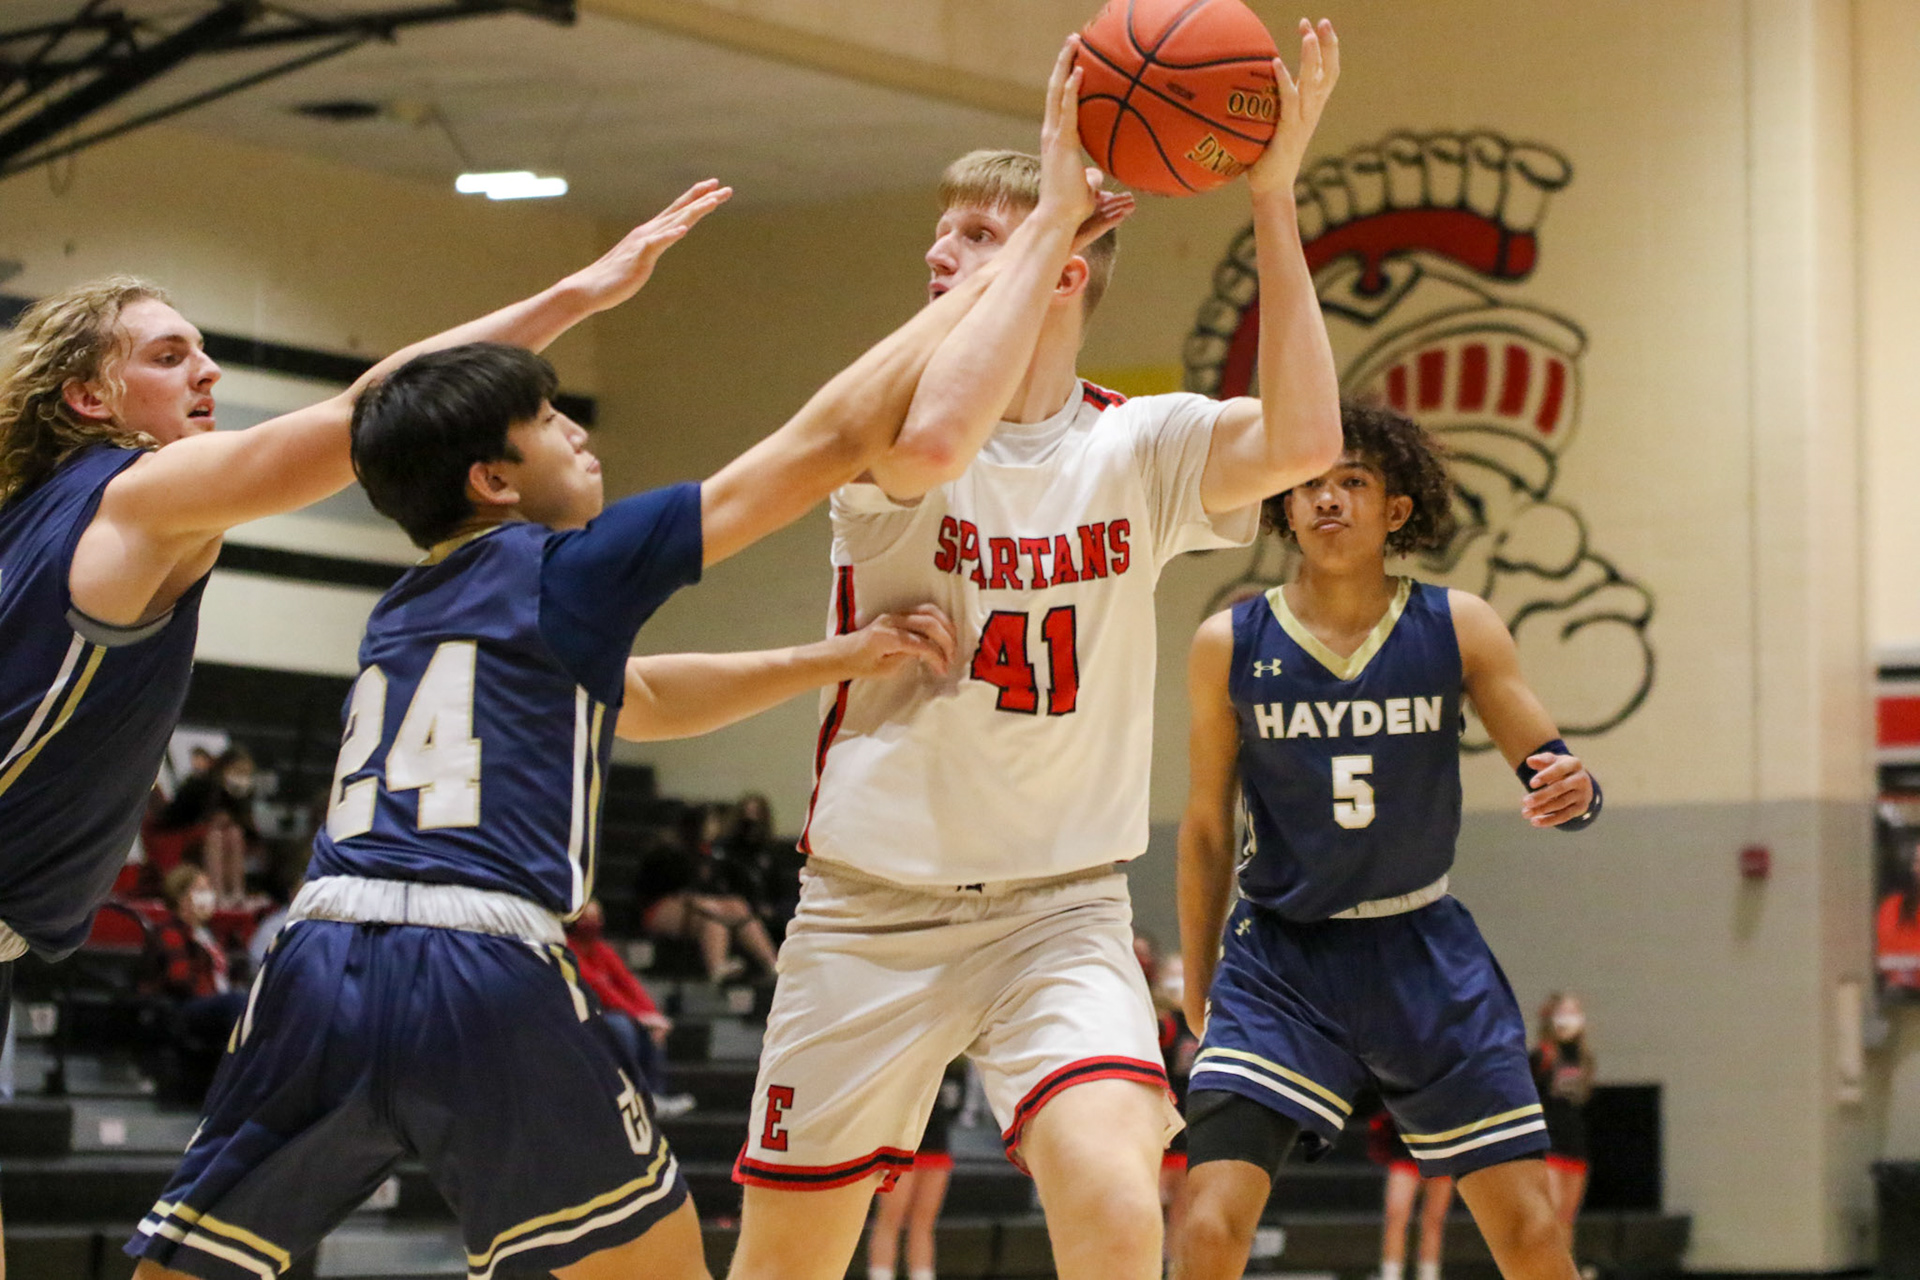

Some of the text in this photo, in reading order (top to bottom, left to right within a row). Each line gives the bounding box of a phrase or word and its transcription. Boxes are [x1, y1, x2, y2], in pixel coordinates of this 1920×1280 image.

[934, 515, 1131, 590] SPARTANS
[969, 604, 1079, 716] 41
[326, 639, 482, 843] 24
[1253, 696, 1443, 739] HAYDEN
[1331, 755, 1376, 829] 5
[761, 1084, 795, 1152] E
